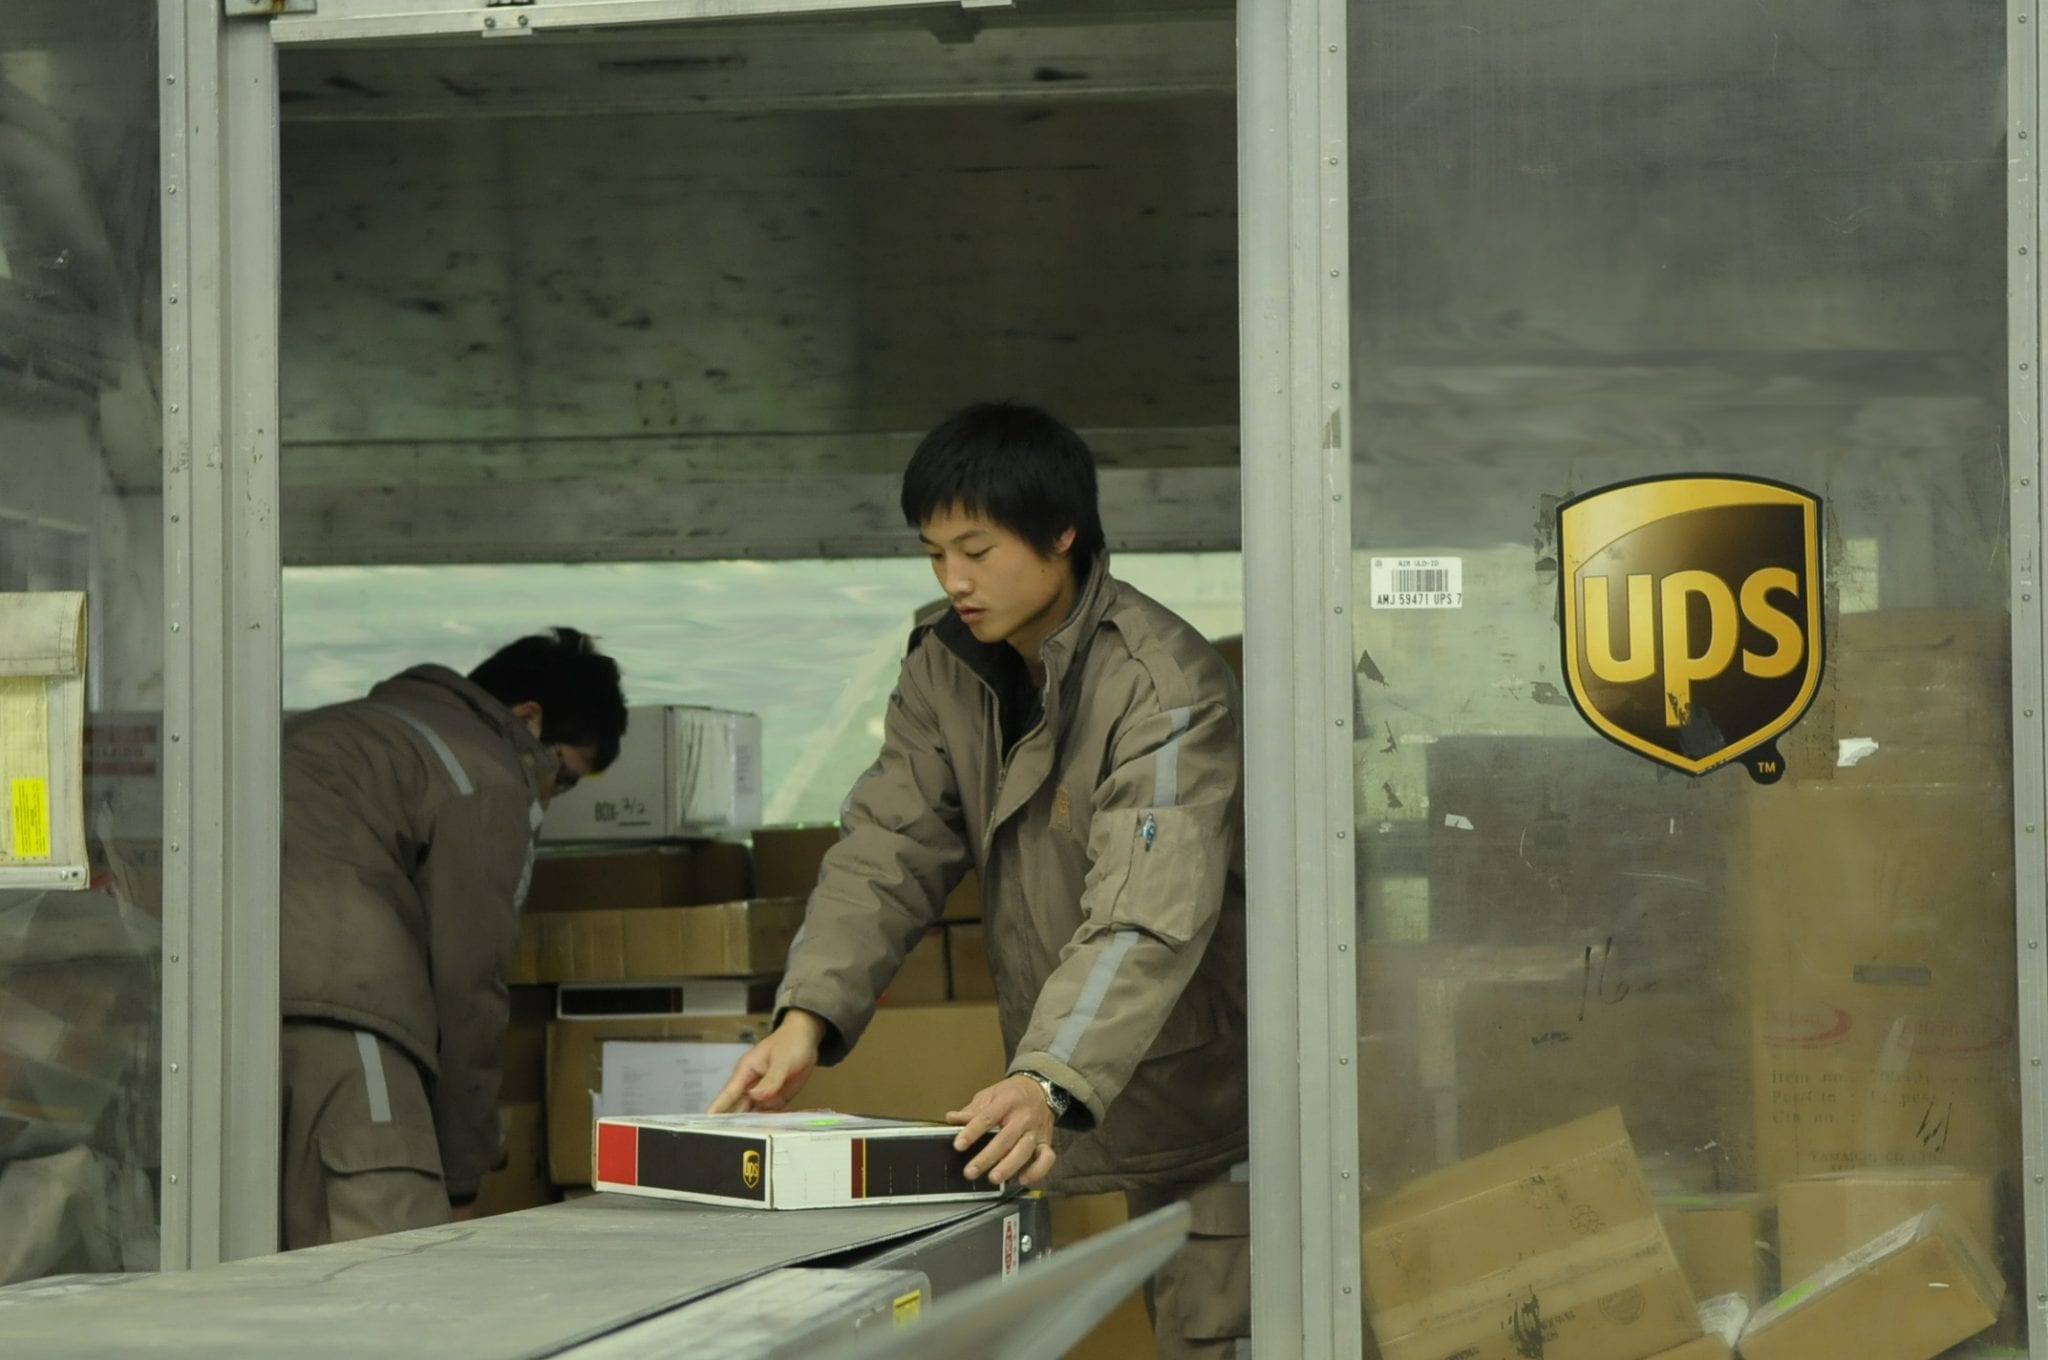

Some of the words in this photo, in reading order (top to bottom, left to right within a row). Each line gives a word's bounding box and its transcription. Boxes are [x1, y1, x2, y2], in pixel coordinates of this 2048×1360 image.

[1377, 593, 1395, 605] AMJ
[1399, 593, 1429, 605] 59471
[1434, 593, 1452, 605] UPS
[1757, 761, 1776, 774] TM
